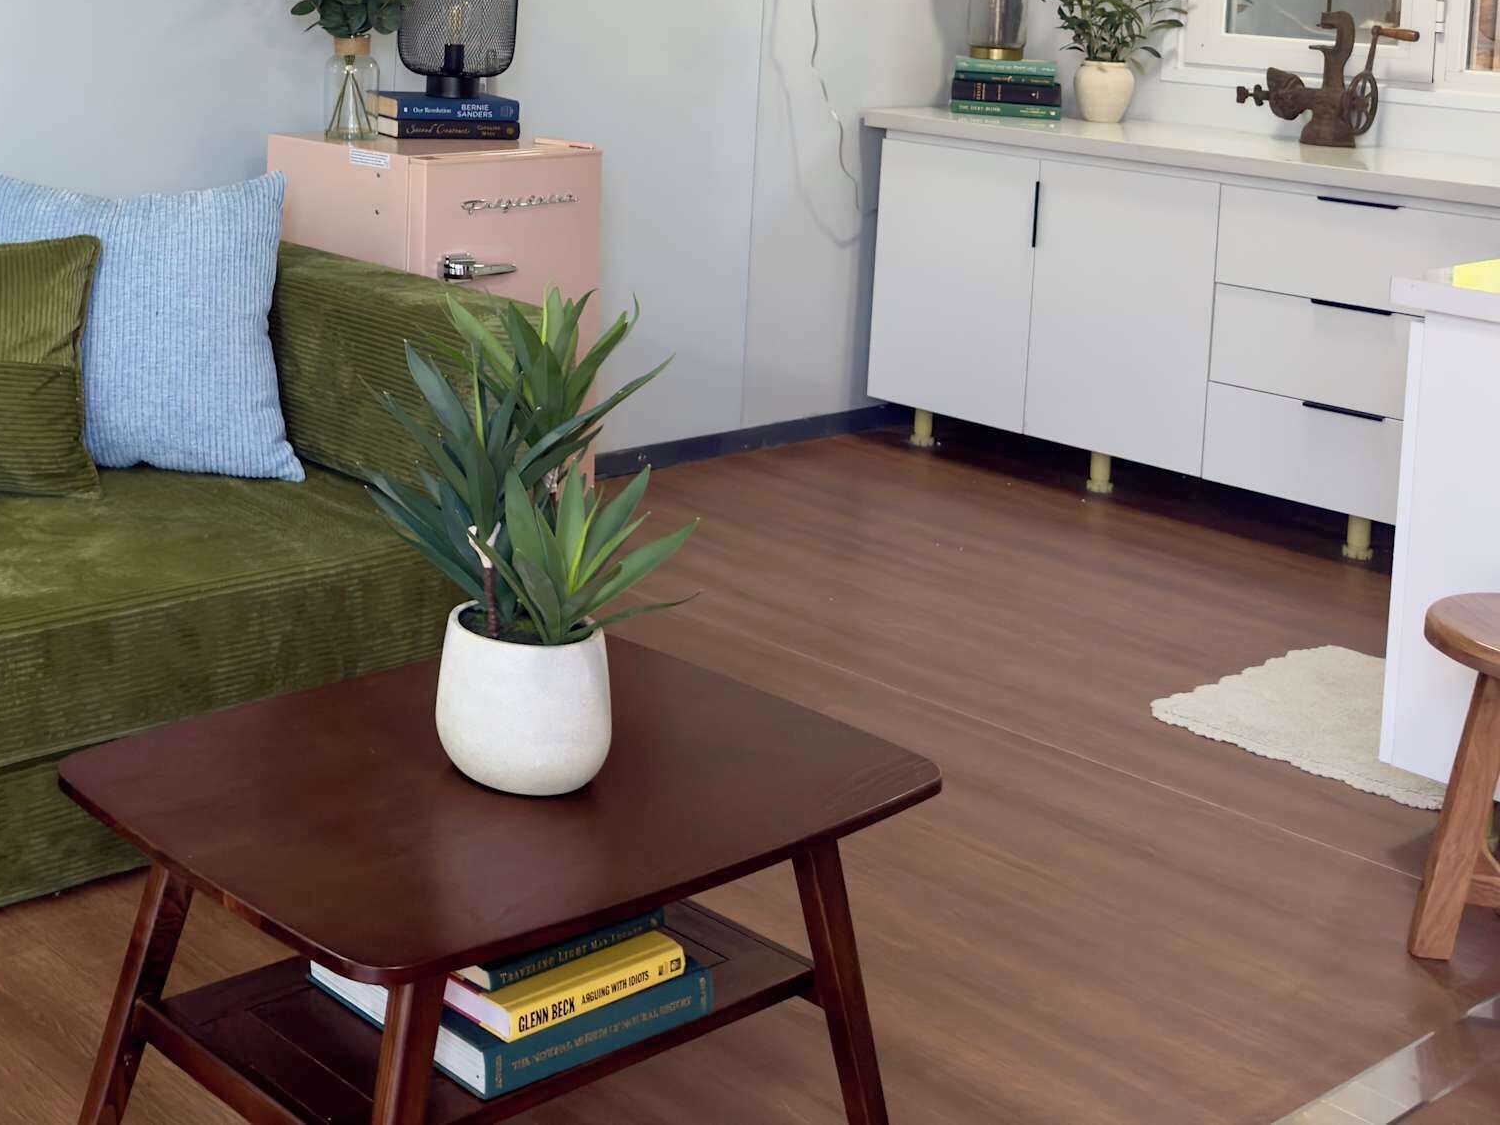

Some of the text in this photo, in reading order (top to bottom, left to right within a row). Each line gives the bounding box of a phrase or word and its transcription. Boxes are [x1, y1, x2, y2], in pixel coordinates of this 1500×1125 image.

[461, 103, 490, 111] BERNIE
[457, 110, 493, 118] SANDERS
[518, 970, 650, 1033] GLENN BECK ARGUING WITH IDIOTS
